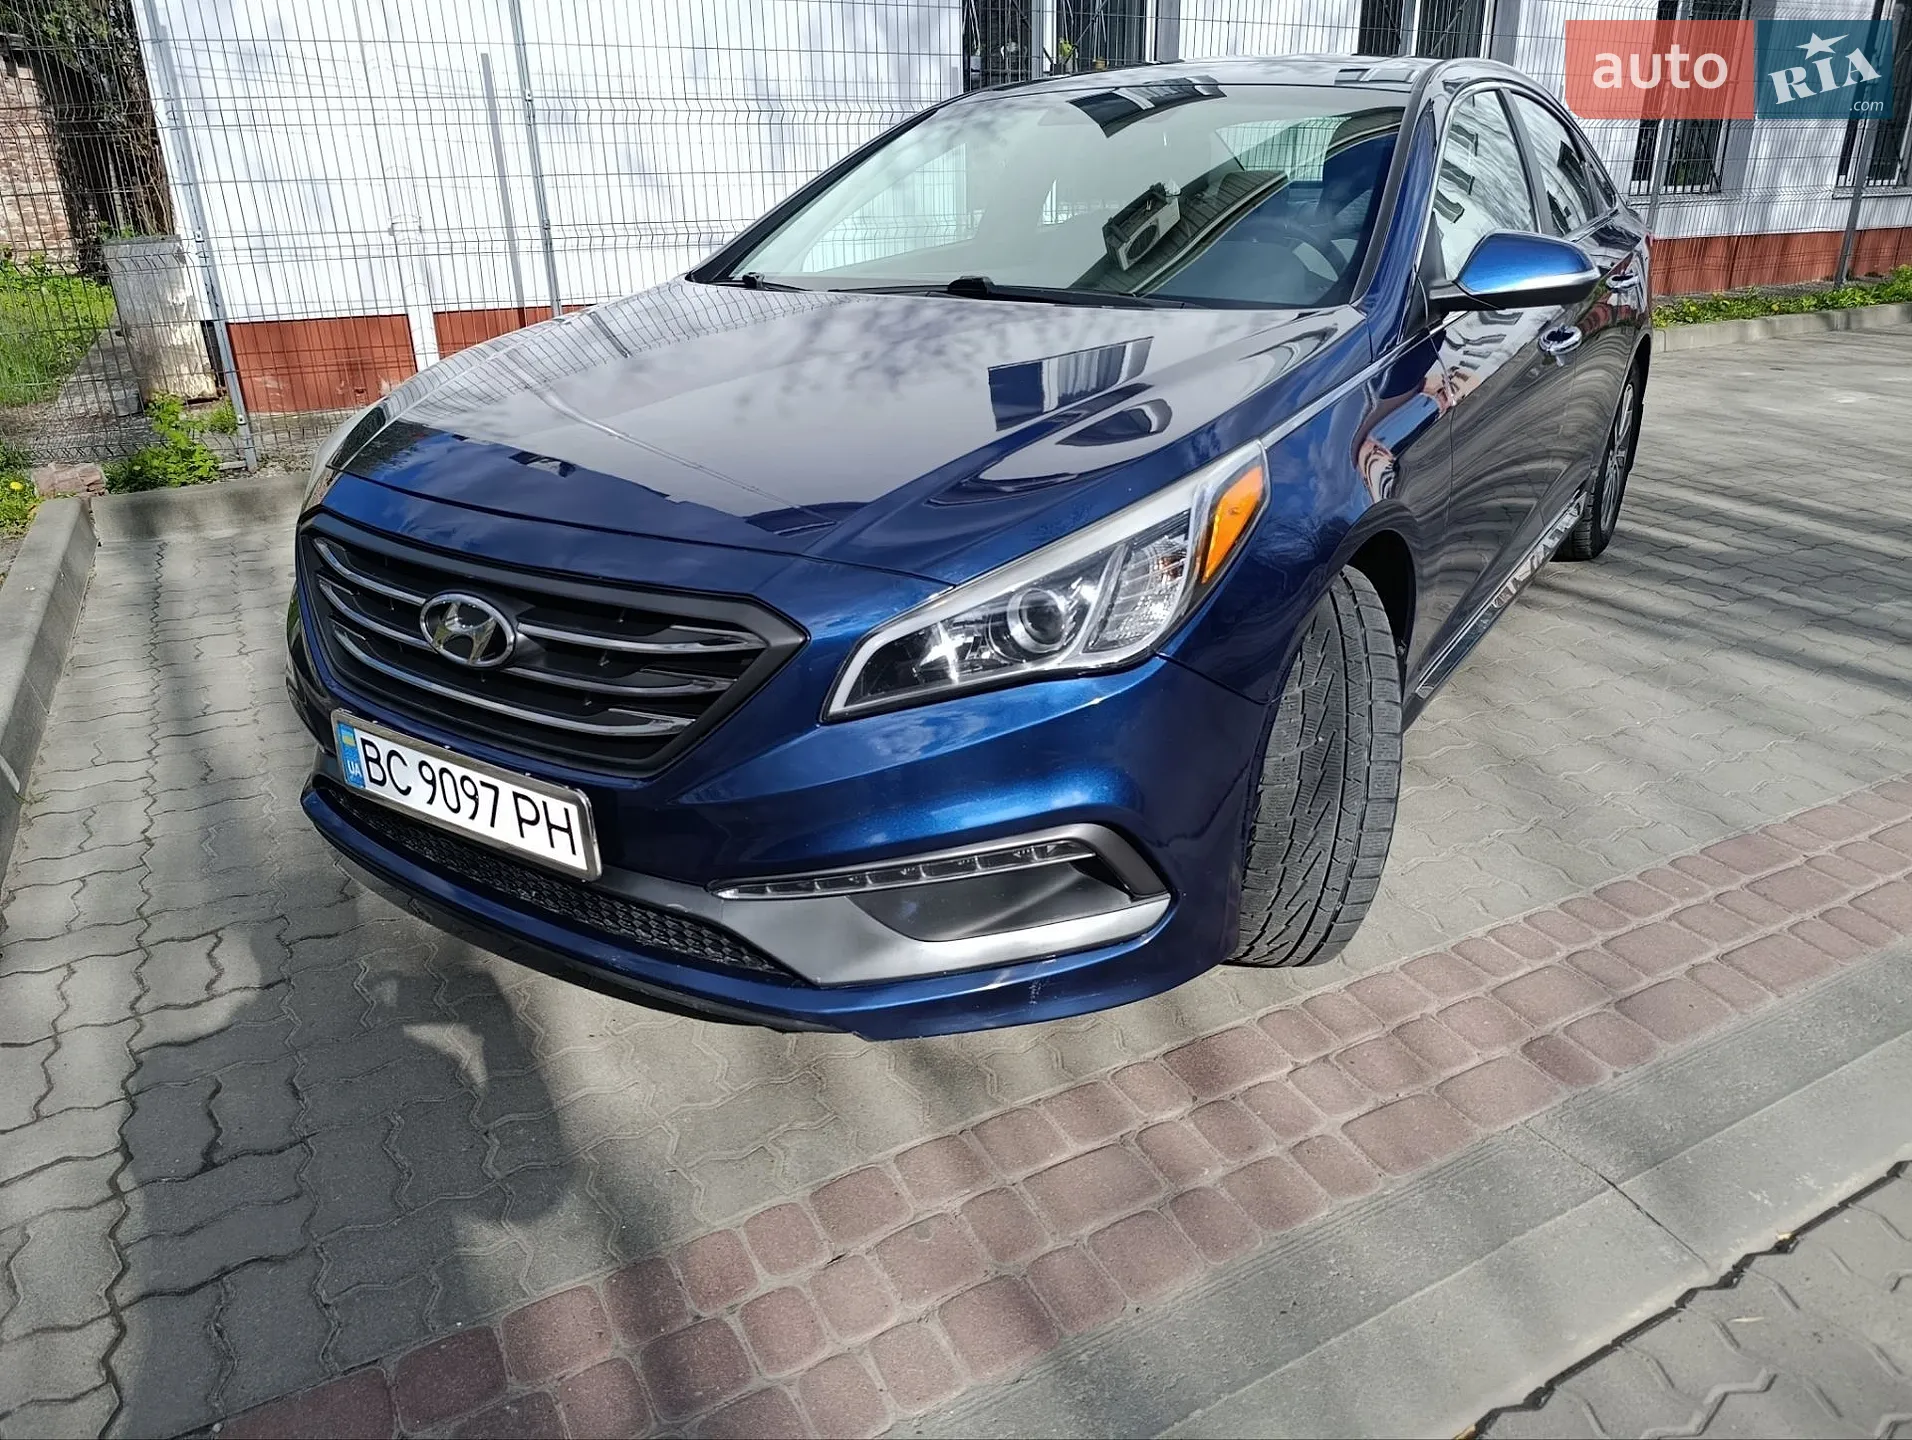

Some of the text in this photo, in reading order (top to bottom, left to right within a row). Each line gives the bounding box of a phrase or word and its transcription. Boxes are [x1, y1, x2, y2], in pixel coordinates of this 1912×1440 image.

[347, 759, 363, 778] UA
[360, 737, 577, 856] BC 9097 PH
